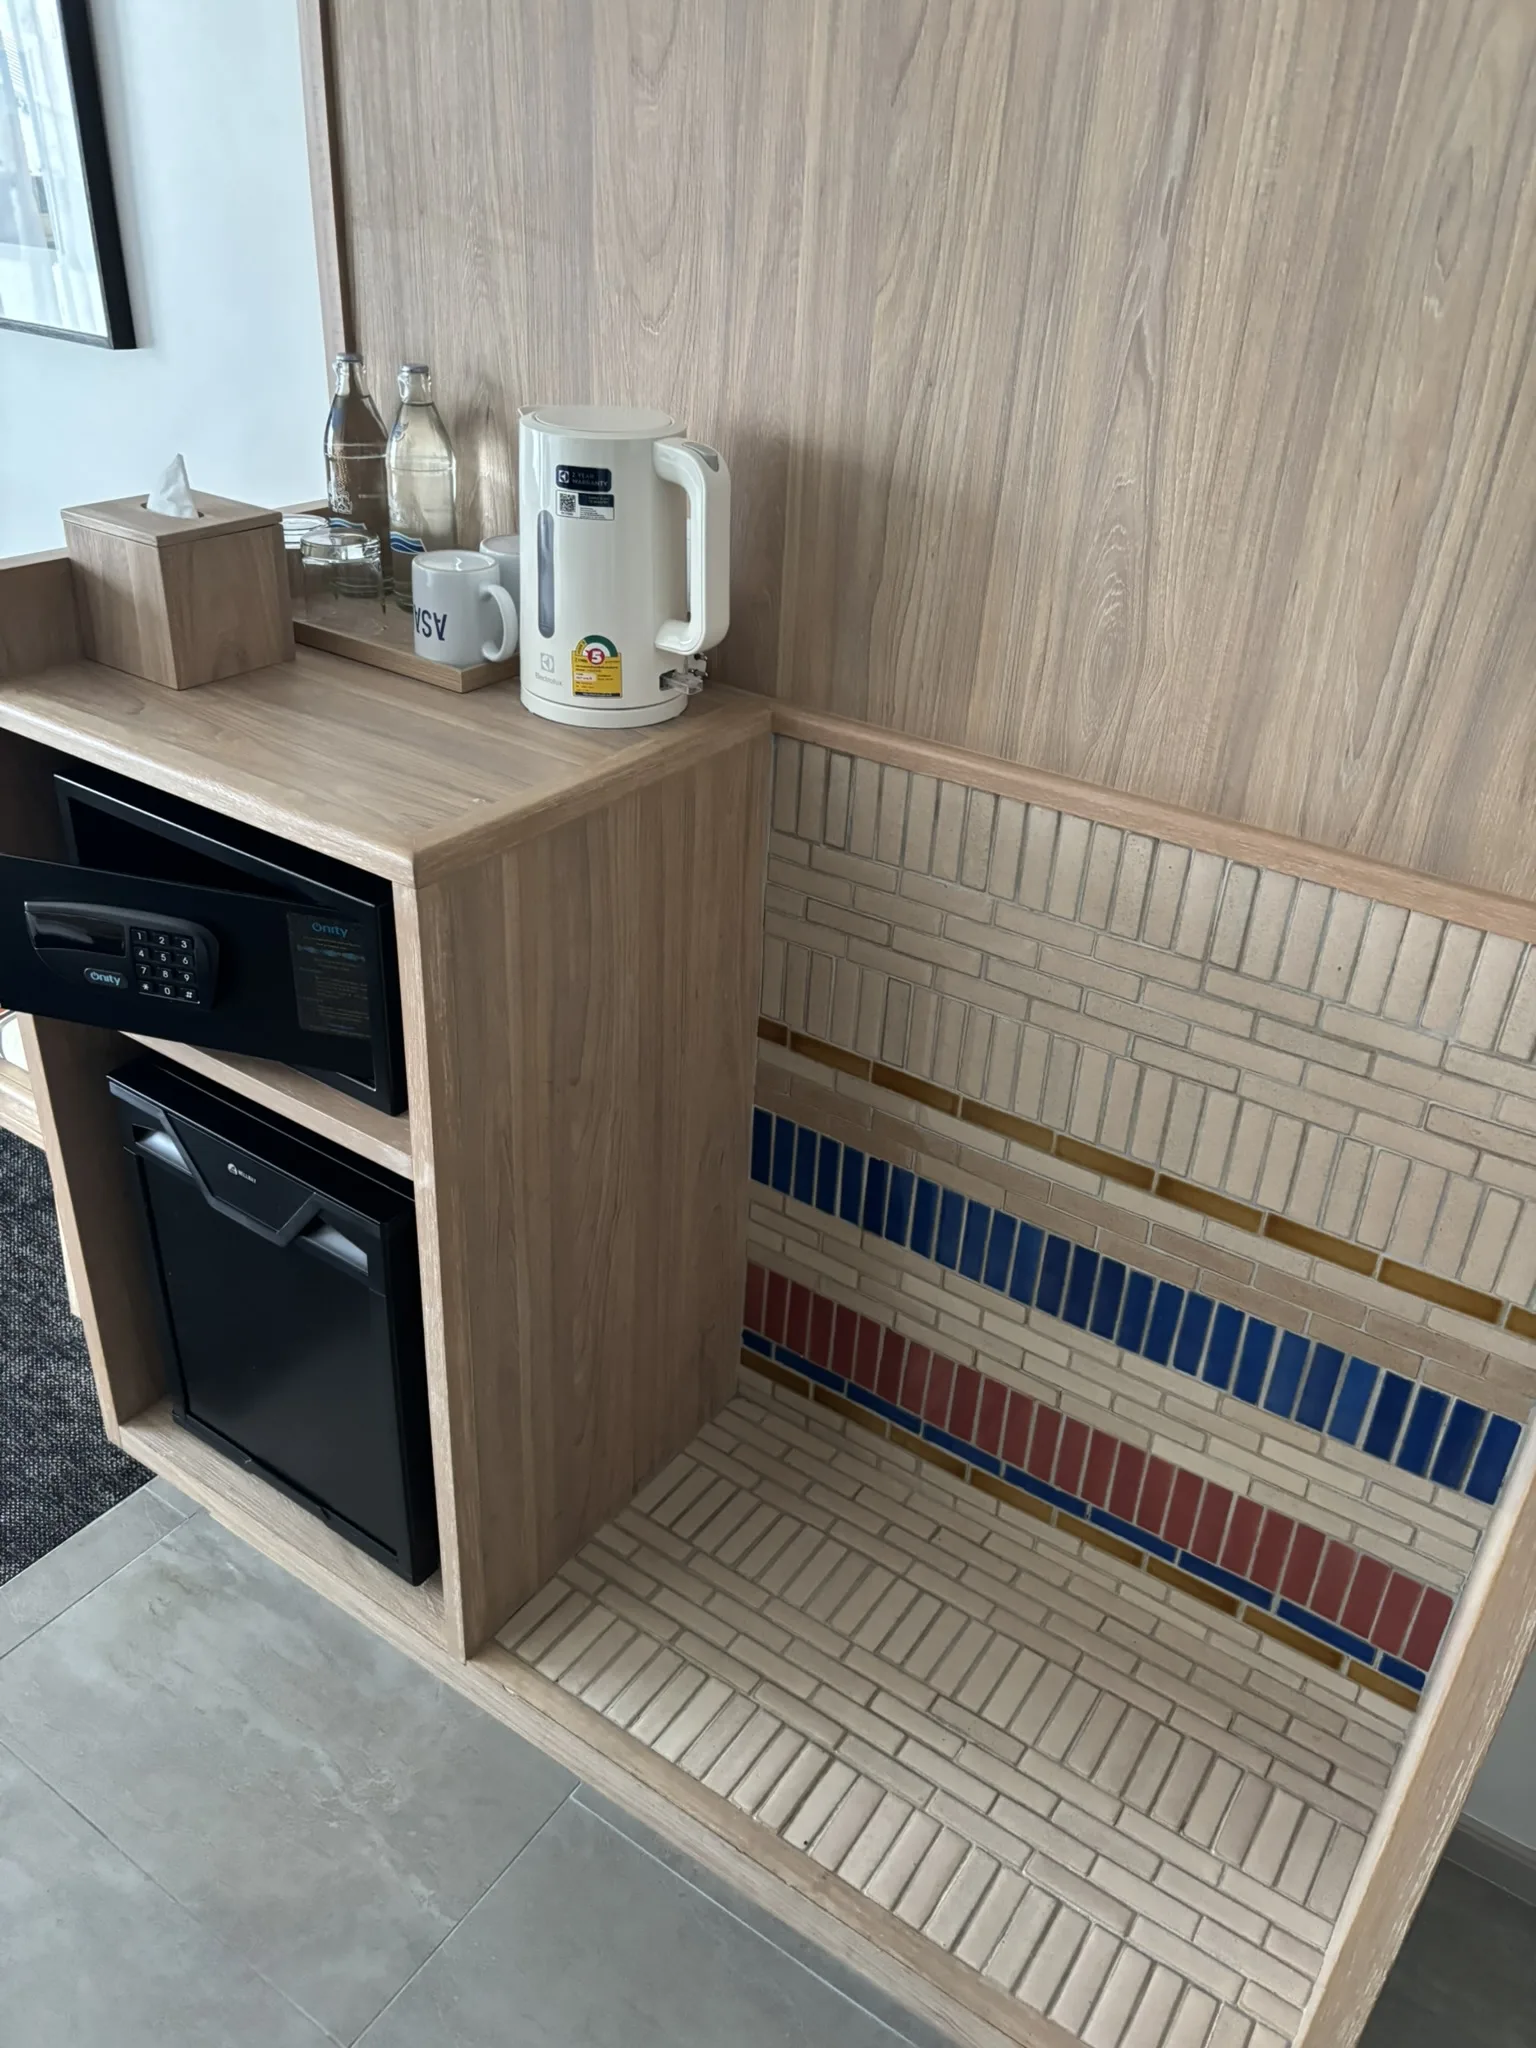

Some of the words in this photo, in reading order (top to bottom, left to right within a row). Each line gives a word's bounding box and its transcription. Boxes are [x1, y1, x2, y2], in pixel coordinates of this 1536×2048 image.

[572, 479, 608, 487] WARRANTY
[591, 650, 602, 664] 5
[535, 671, 564, 688] Electrolux
[312, 922, 349, 938] Onity
[137, 932, 142, 940] 1
[158, 936, 165, 945] 2
[180, 940, 188, 949] 3
[138, 949, 145, 957] 4
[160, 953, 167, 962] 5
[182, 956, 189, 965] 6
[90, 971, 121, 986] Onity
[140, 966, 147, 974] 7
[162, 970, 169, 978] 8
[183, 973, 190, 982] 9
[163, 987, 171, 995] 0
